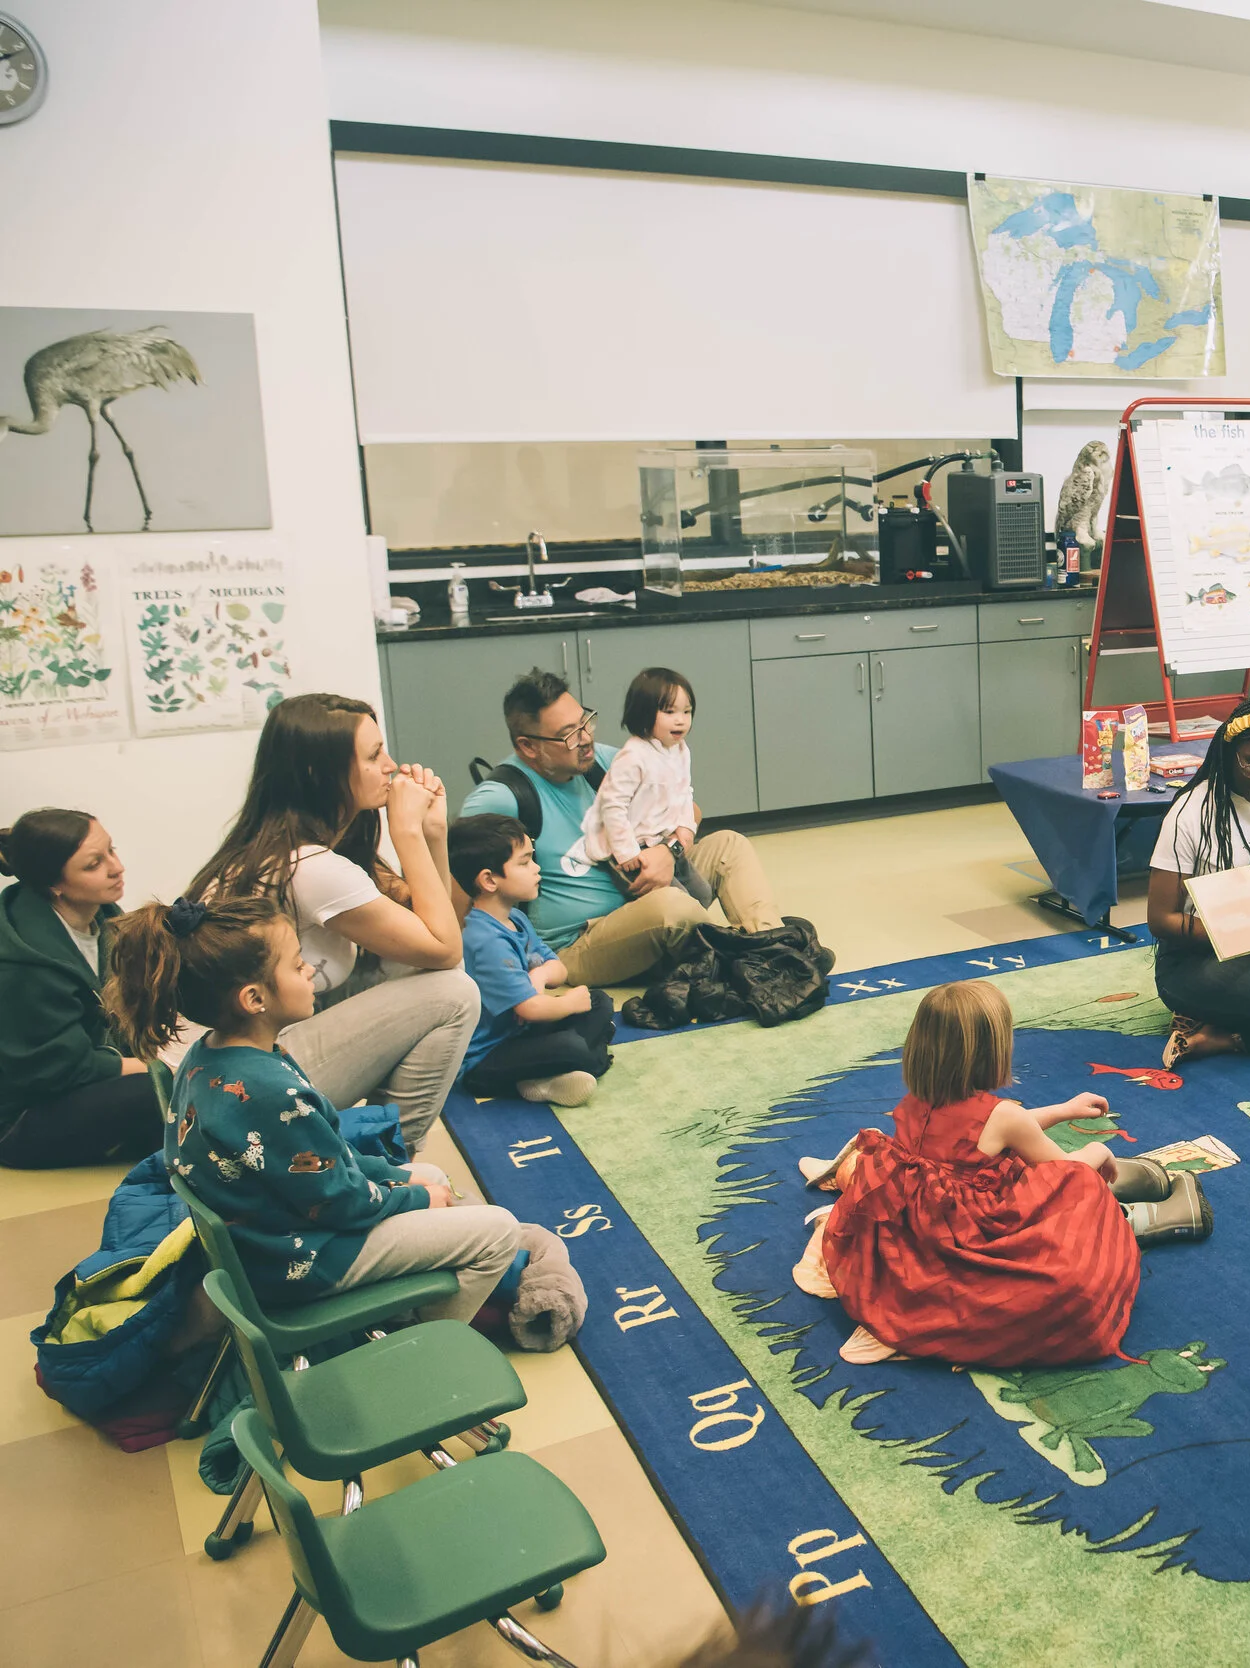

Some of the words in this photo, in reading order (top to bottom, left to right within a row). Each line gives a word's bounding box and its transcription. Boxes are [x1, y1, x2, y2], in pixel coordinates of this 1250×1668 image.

[1194, 424, 1217, 438] the
[1221, 423, 1245, 438] fish
[131, 589, 183, 601] TREES
[209, 586, 285, 598] MICHIGAN
[966, 954, 1026, 970] Yy
[836, 977, 908, 996] Xx
[508, 1135, 563, 1169] Tt
[555, 1204, 614, 1238] Ss
[613, 1284, 681, 1333] Rr
[687, 1377, 766, 1452] Qq
[787, 1528, 873, 1607] Pp
